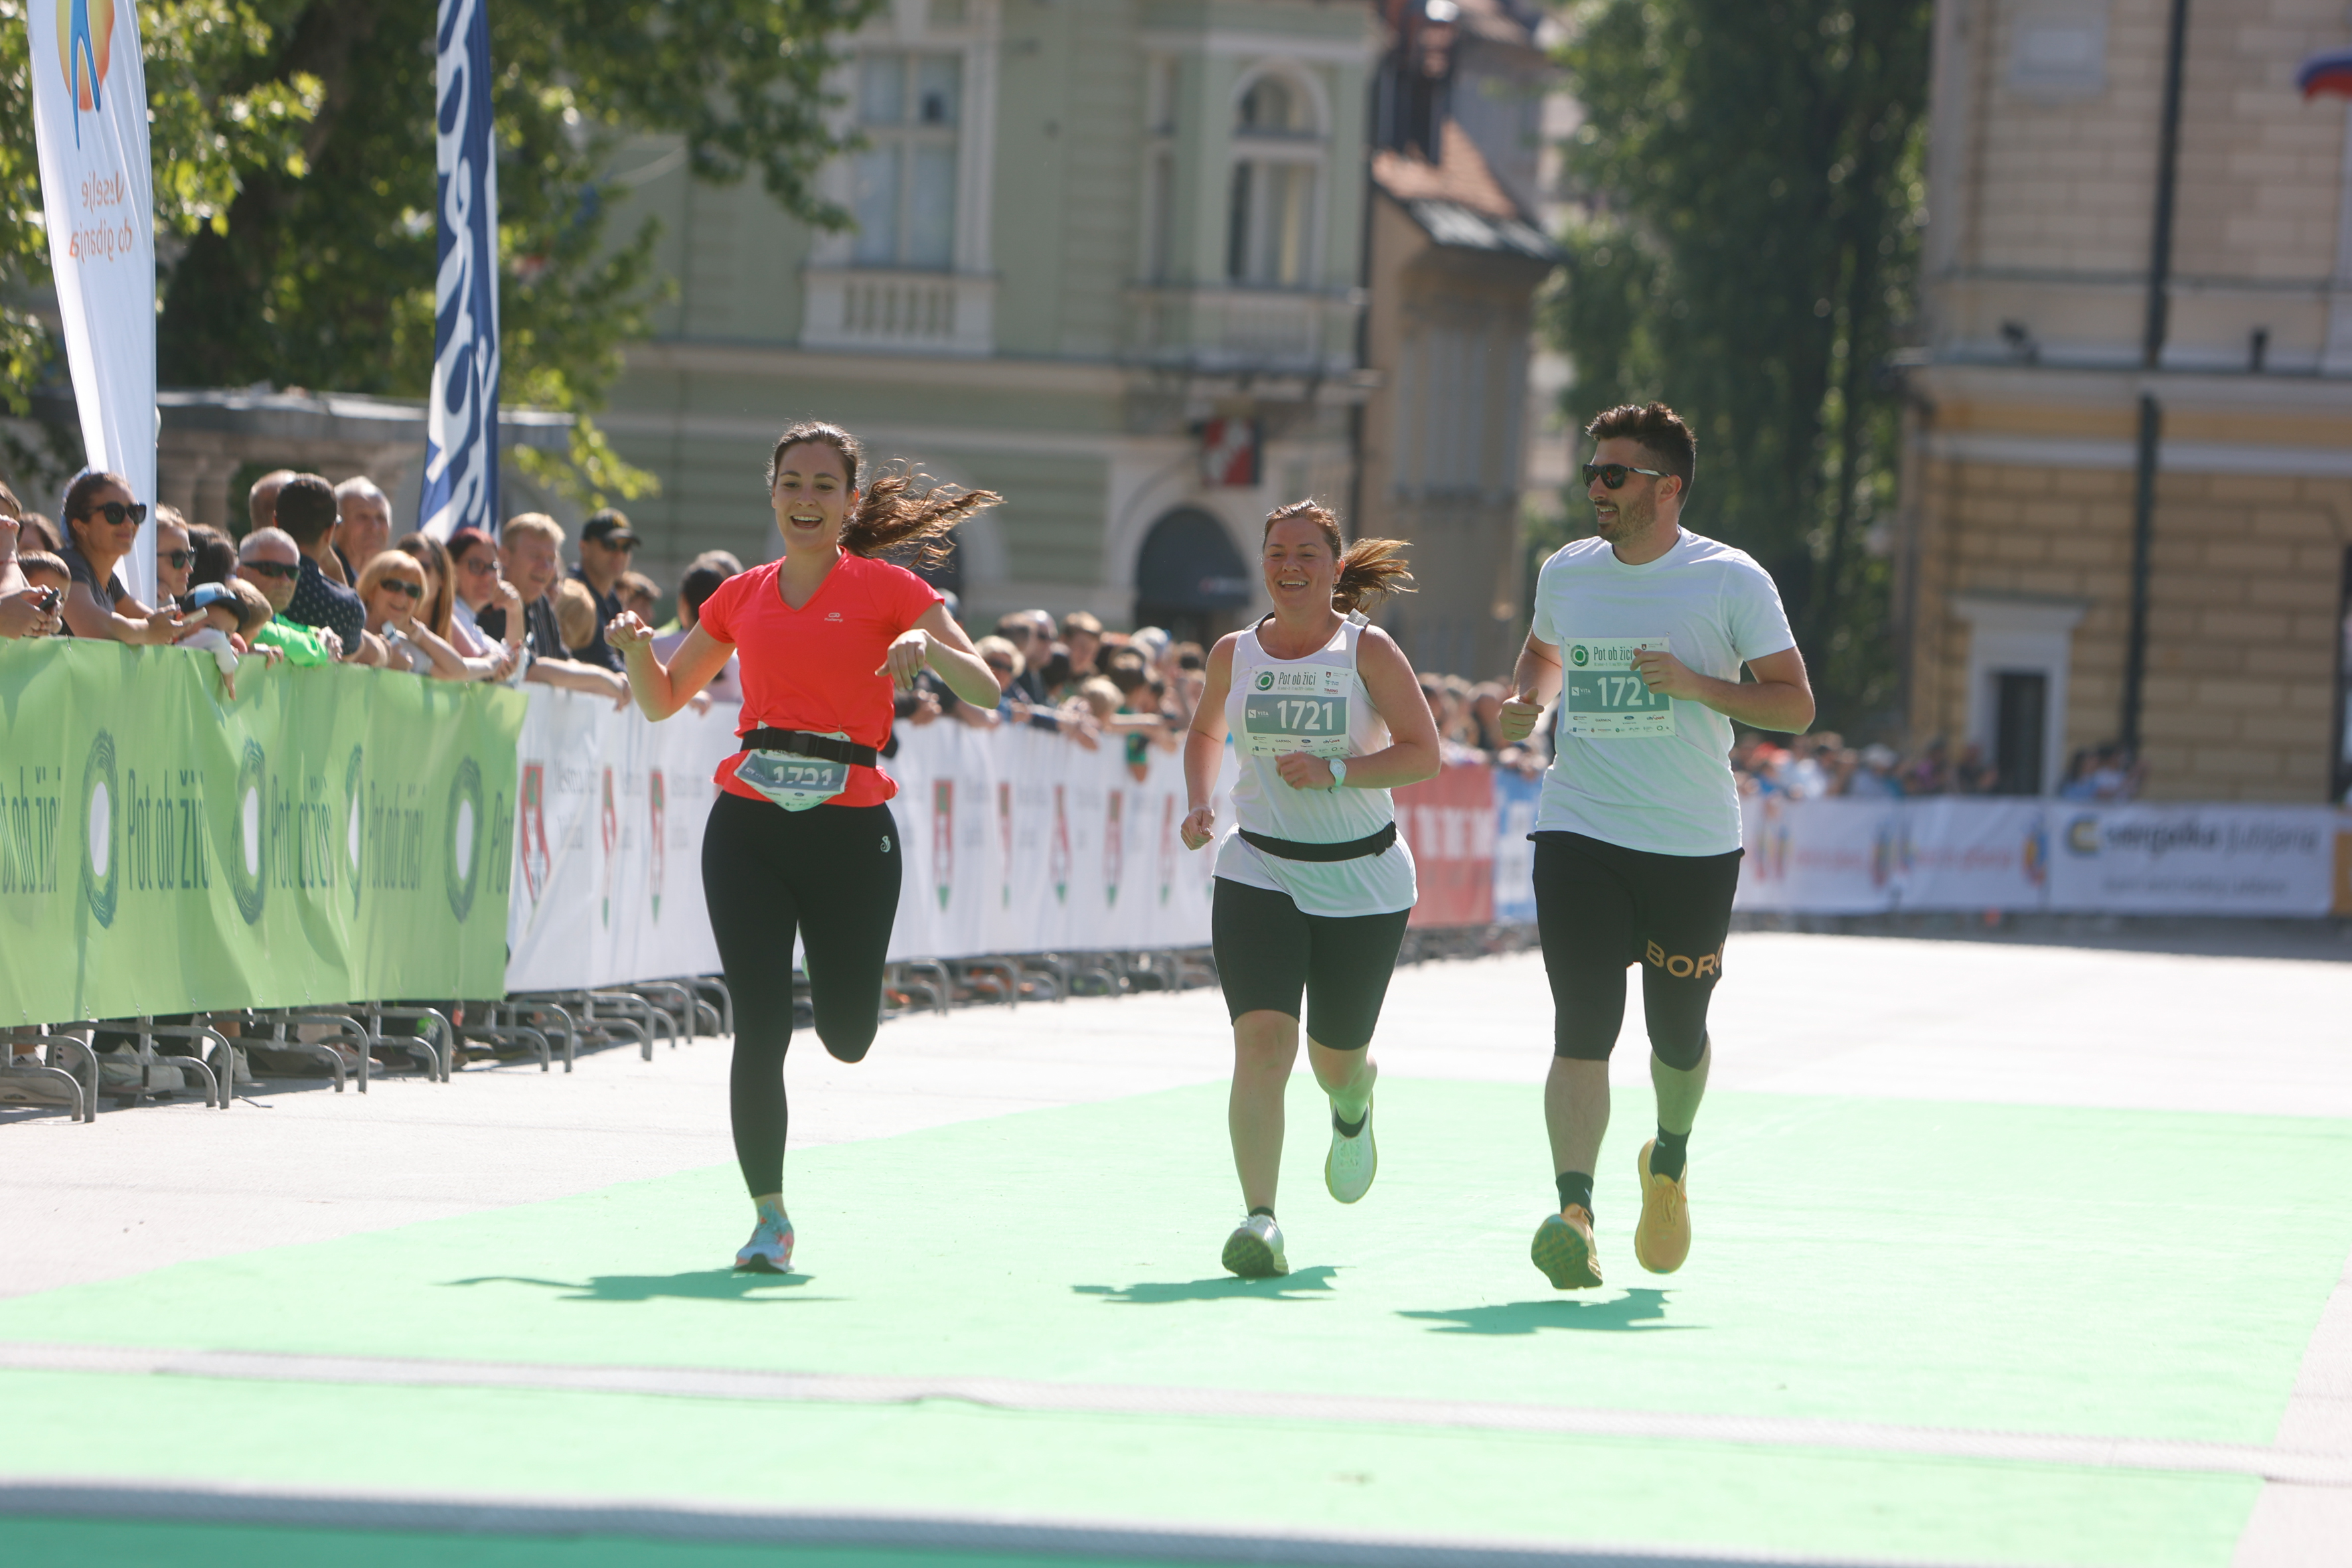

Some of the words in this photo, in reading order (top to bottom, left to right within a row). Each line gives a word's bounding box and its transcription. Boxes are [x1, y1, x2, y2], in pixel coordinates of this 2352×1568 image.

[1278, 671, 1291, 686] Pot
[1292, 671, 1302, 686] ob
[1303, 671, 1316, 686] žici
[1593, 646, 1606, 661] Pot
[1608, 646, 1618, 661] ob
[1620, 646, 1633, 661] žici
[1277, 700, 1333, 730] 1721
[12, 766, 36, 894] ob
[127, 769, 152, 890] Pot
[155, 769, 175, 890] ob
[179, 769, 212, 890] žici
[271, 774, 293, 888] Pot
[366, 780, 384, 888] Pot
[384, 783, 401, 890] ob
